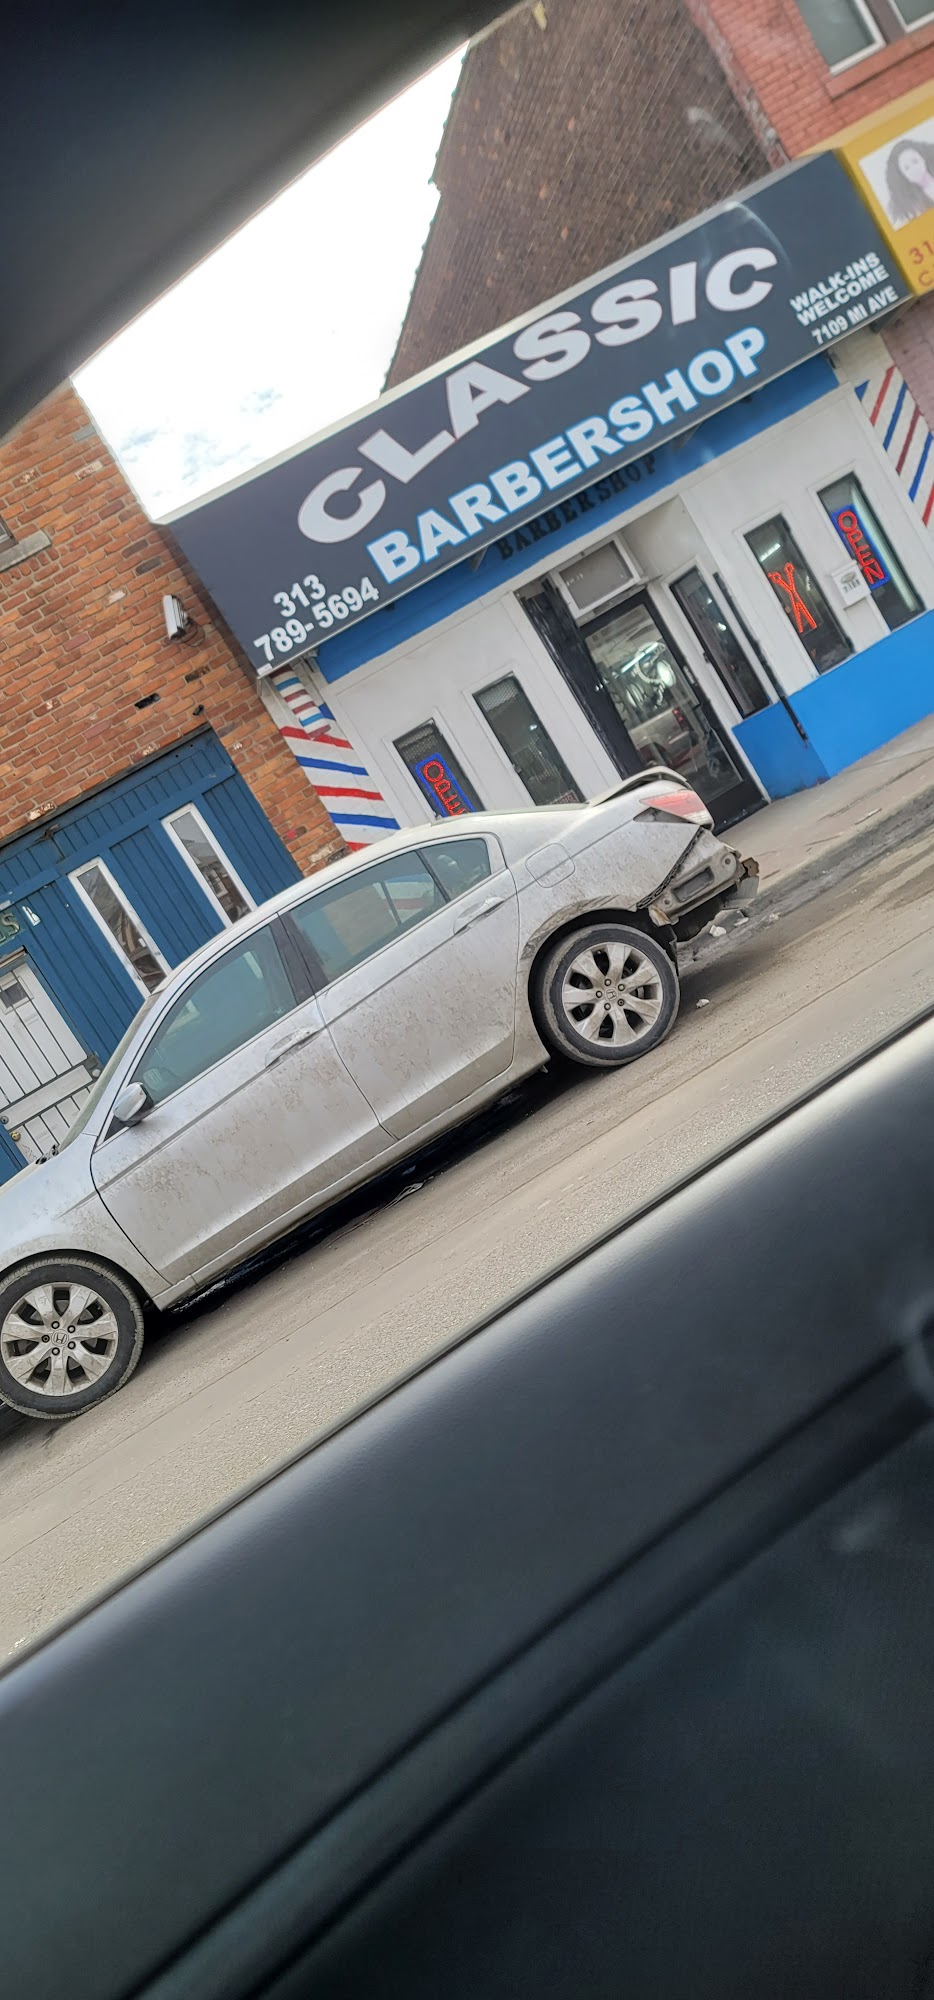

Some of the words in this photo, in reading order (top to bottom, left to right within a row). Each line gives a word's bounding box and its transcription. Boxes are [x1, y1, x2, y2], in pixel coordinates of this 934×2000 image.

[790, 252, 881, 312] WALK-INS
[796, 264, 889, 327] WELCOME
[811, 315, 848, 345] 7109
[847, 303, 868, 325] MI
[868, 285, 899, 314] AVE
[298, 247, 778, 543] CLASSIC
[367, 327, 767, 584] BARBERSHOP
[497, 491, 595, 560] BARBER
[837, 510, 885, 584] OPEN
[253, 576, 380, 661] 789-5694
[273, 574, 326, 617] 313
[423, 760, 469, 817] OPE
